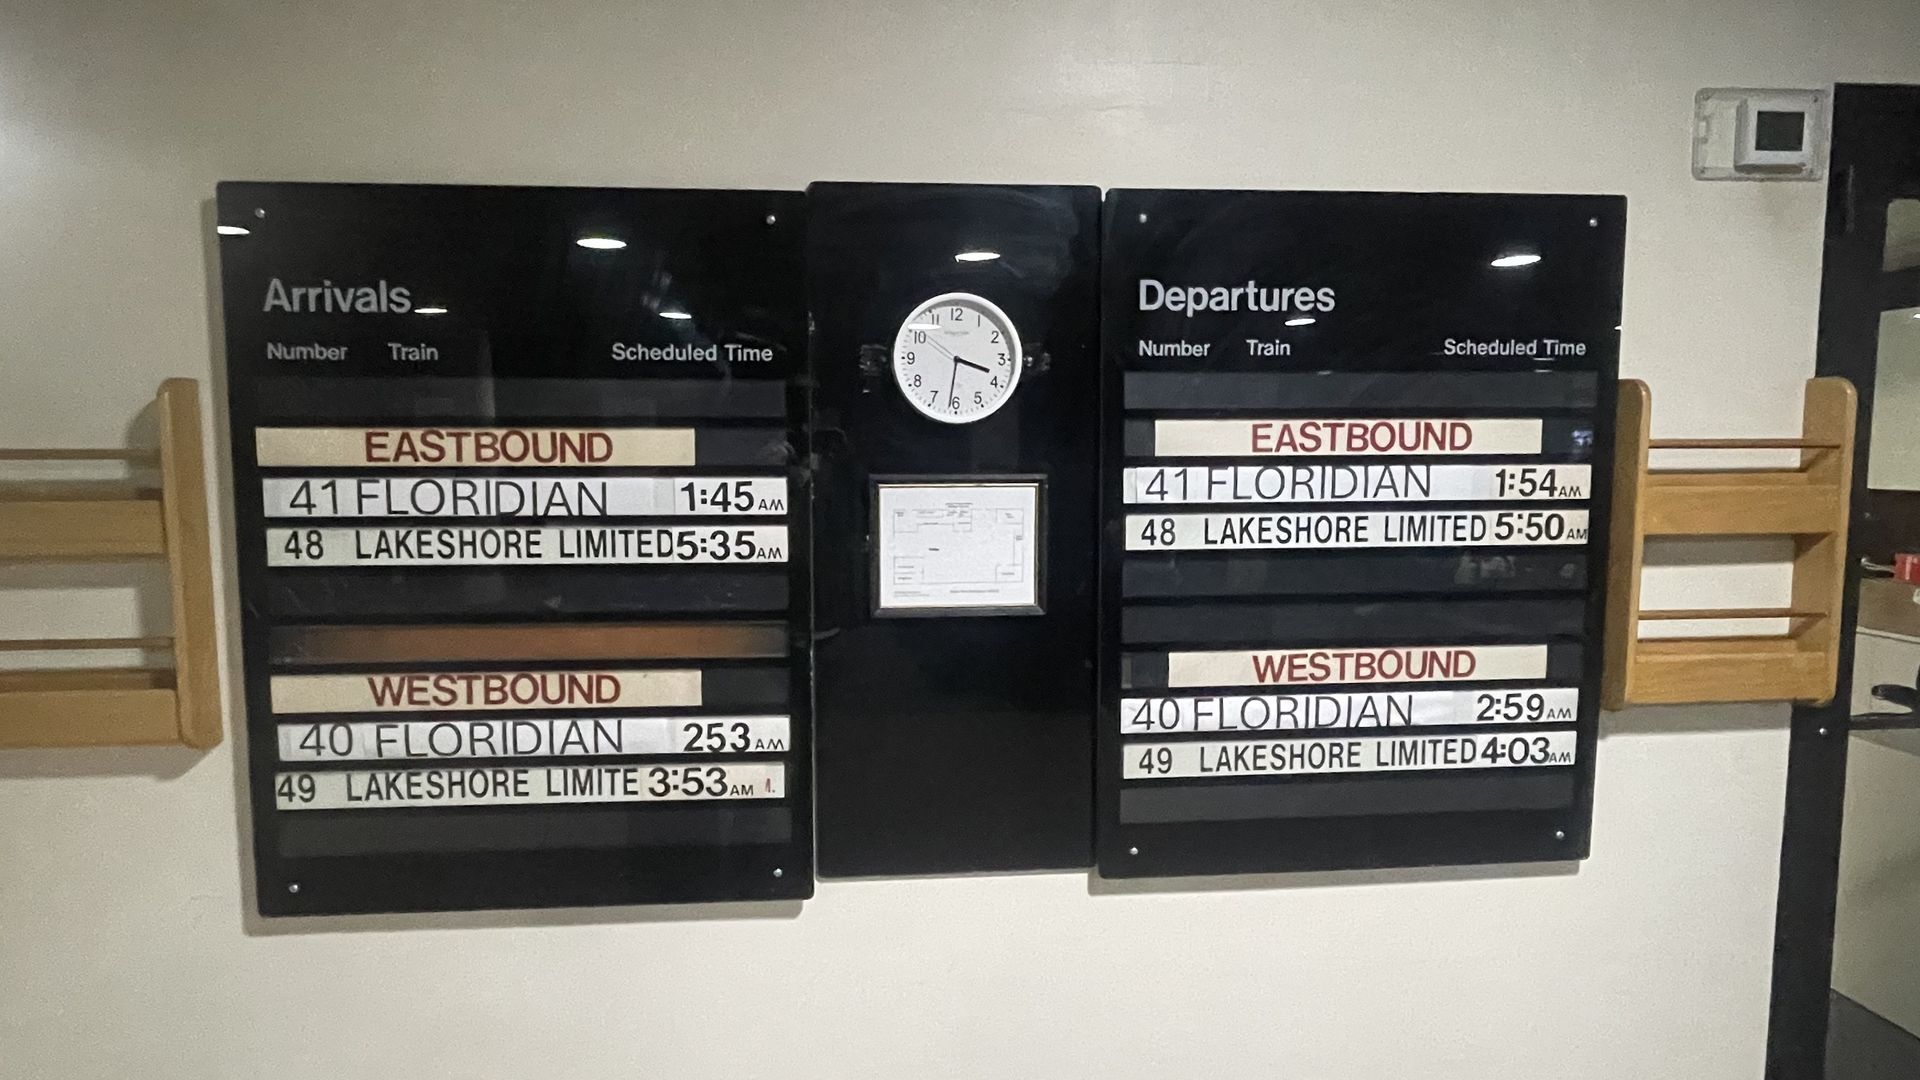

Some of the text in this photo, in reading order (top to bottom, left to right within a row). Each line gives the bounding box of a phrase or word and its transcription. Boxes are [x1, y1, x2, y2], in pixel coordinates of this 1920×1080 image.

[263, 278, 411, 313] Arrivals
[1139, 279, 1335, 316] Departures
[951, 308, 963, 321] 12
[914, 331, 926, 343] 10
[991, 331, 999, 343] 2
[267, 342, 348, 361] Number
[388, 343, 438, 361] Train
[612, 343, 773, 362] Scheduled Time
[1139, 340, 1210, 357] Number
[1246, 340, 1290, 356] Train
[1444, 339, 1586, 356] Scheduled Time
[907, 352, 915, 364] 9
[998, 353, 1005, 365] 3
[914, 375, 921, 387] 8
[991, 376, 998, 387] 4
[931, 391, 938, 403] 7
[952, 397, 960, 409] 6
[974, 392, 982, 404] 5
[365, 430, 613, 463] EASTBOUND
[1251, 422, 1471, 453] EASTBOUND
[1146, 466, 1581, 500] 41 FLORIDIAN 1:54 AM
[289, 480, 784, 516] 41 FLORIDIAN 1:45 AM
[1141, 512, 1587, 545] 48 LAKESHORE LIMITED 5:50 AM
[284, 530, 782, 560] 48 LAKESHORE LIMITED 5:35 AM
[1252, 650, 1476, 683] WESTBOUND
[368, 674, 621, 707] WESTBOUND
[1132, 694, 1571, 731] 40 FLORIDIAN 2:59 AM
[300, 720, 784, 758] 40 FLORIDIAN 253 AM
[1139, 737, 1571, 774] 49 LAKESHORE LIMITED 4:03 AM
[277, 773, 315, 803] 49
[347, 769, 529, 802] LAKESHORE
[648, 767, 728, 797] 3:53
[730, 785, 753, 796] AM
